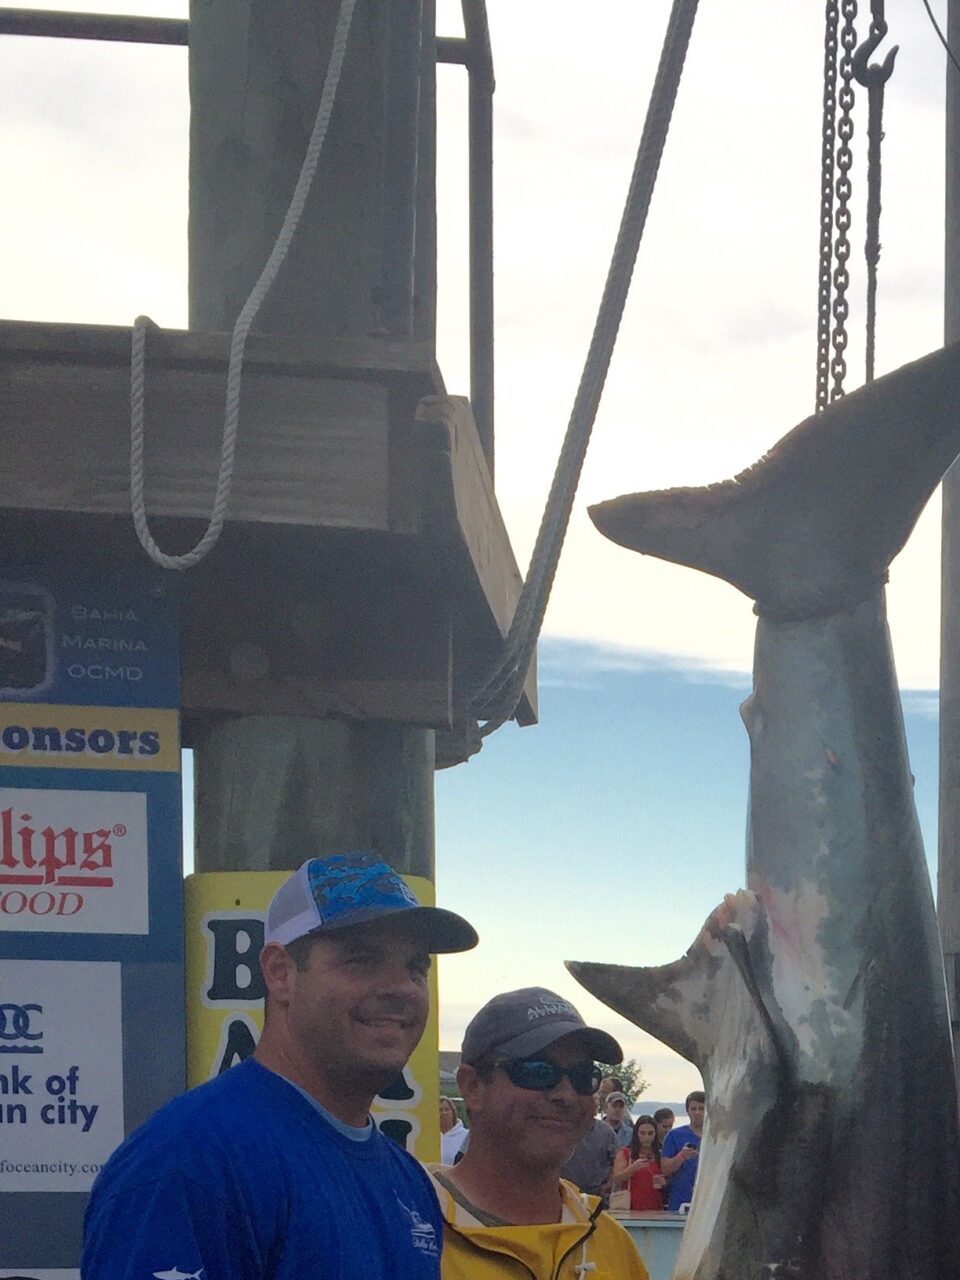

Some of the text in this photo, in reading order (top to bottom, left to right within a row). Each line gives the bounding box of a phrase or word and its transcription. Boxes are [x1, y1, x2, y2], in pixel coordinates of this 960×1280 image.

[71, 605, 138, 621] BAHIA
[62, 634, 147, 651] MARINA
[67, 664, 143, 681] OCMD
[2, 724, 161, 756] onsors
[0, 890, 84, 916] OOD
[45, 1065, 80, 1096] of
[40, 1095, 99, 1133] city
[0, 1159, 104, 1177] foceancity.co
